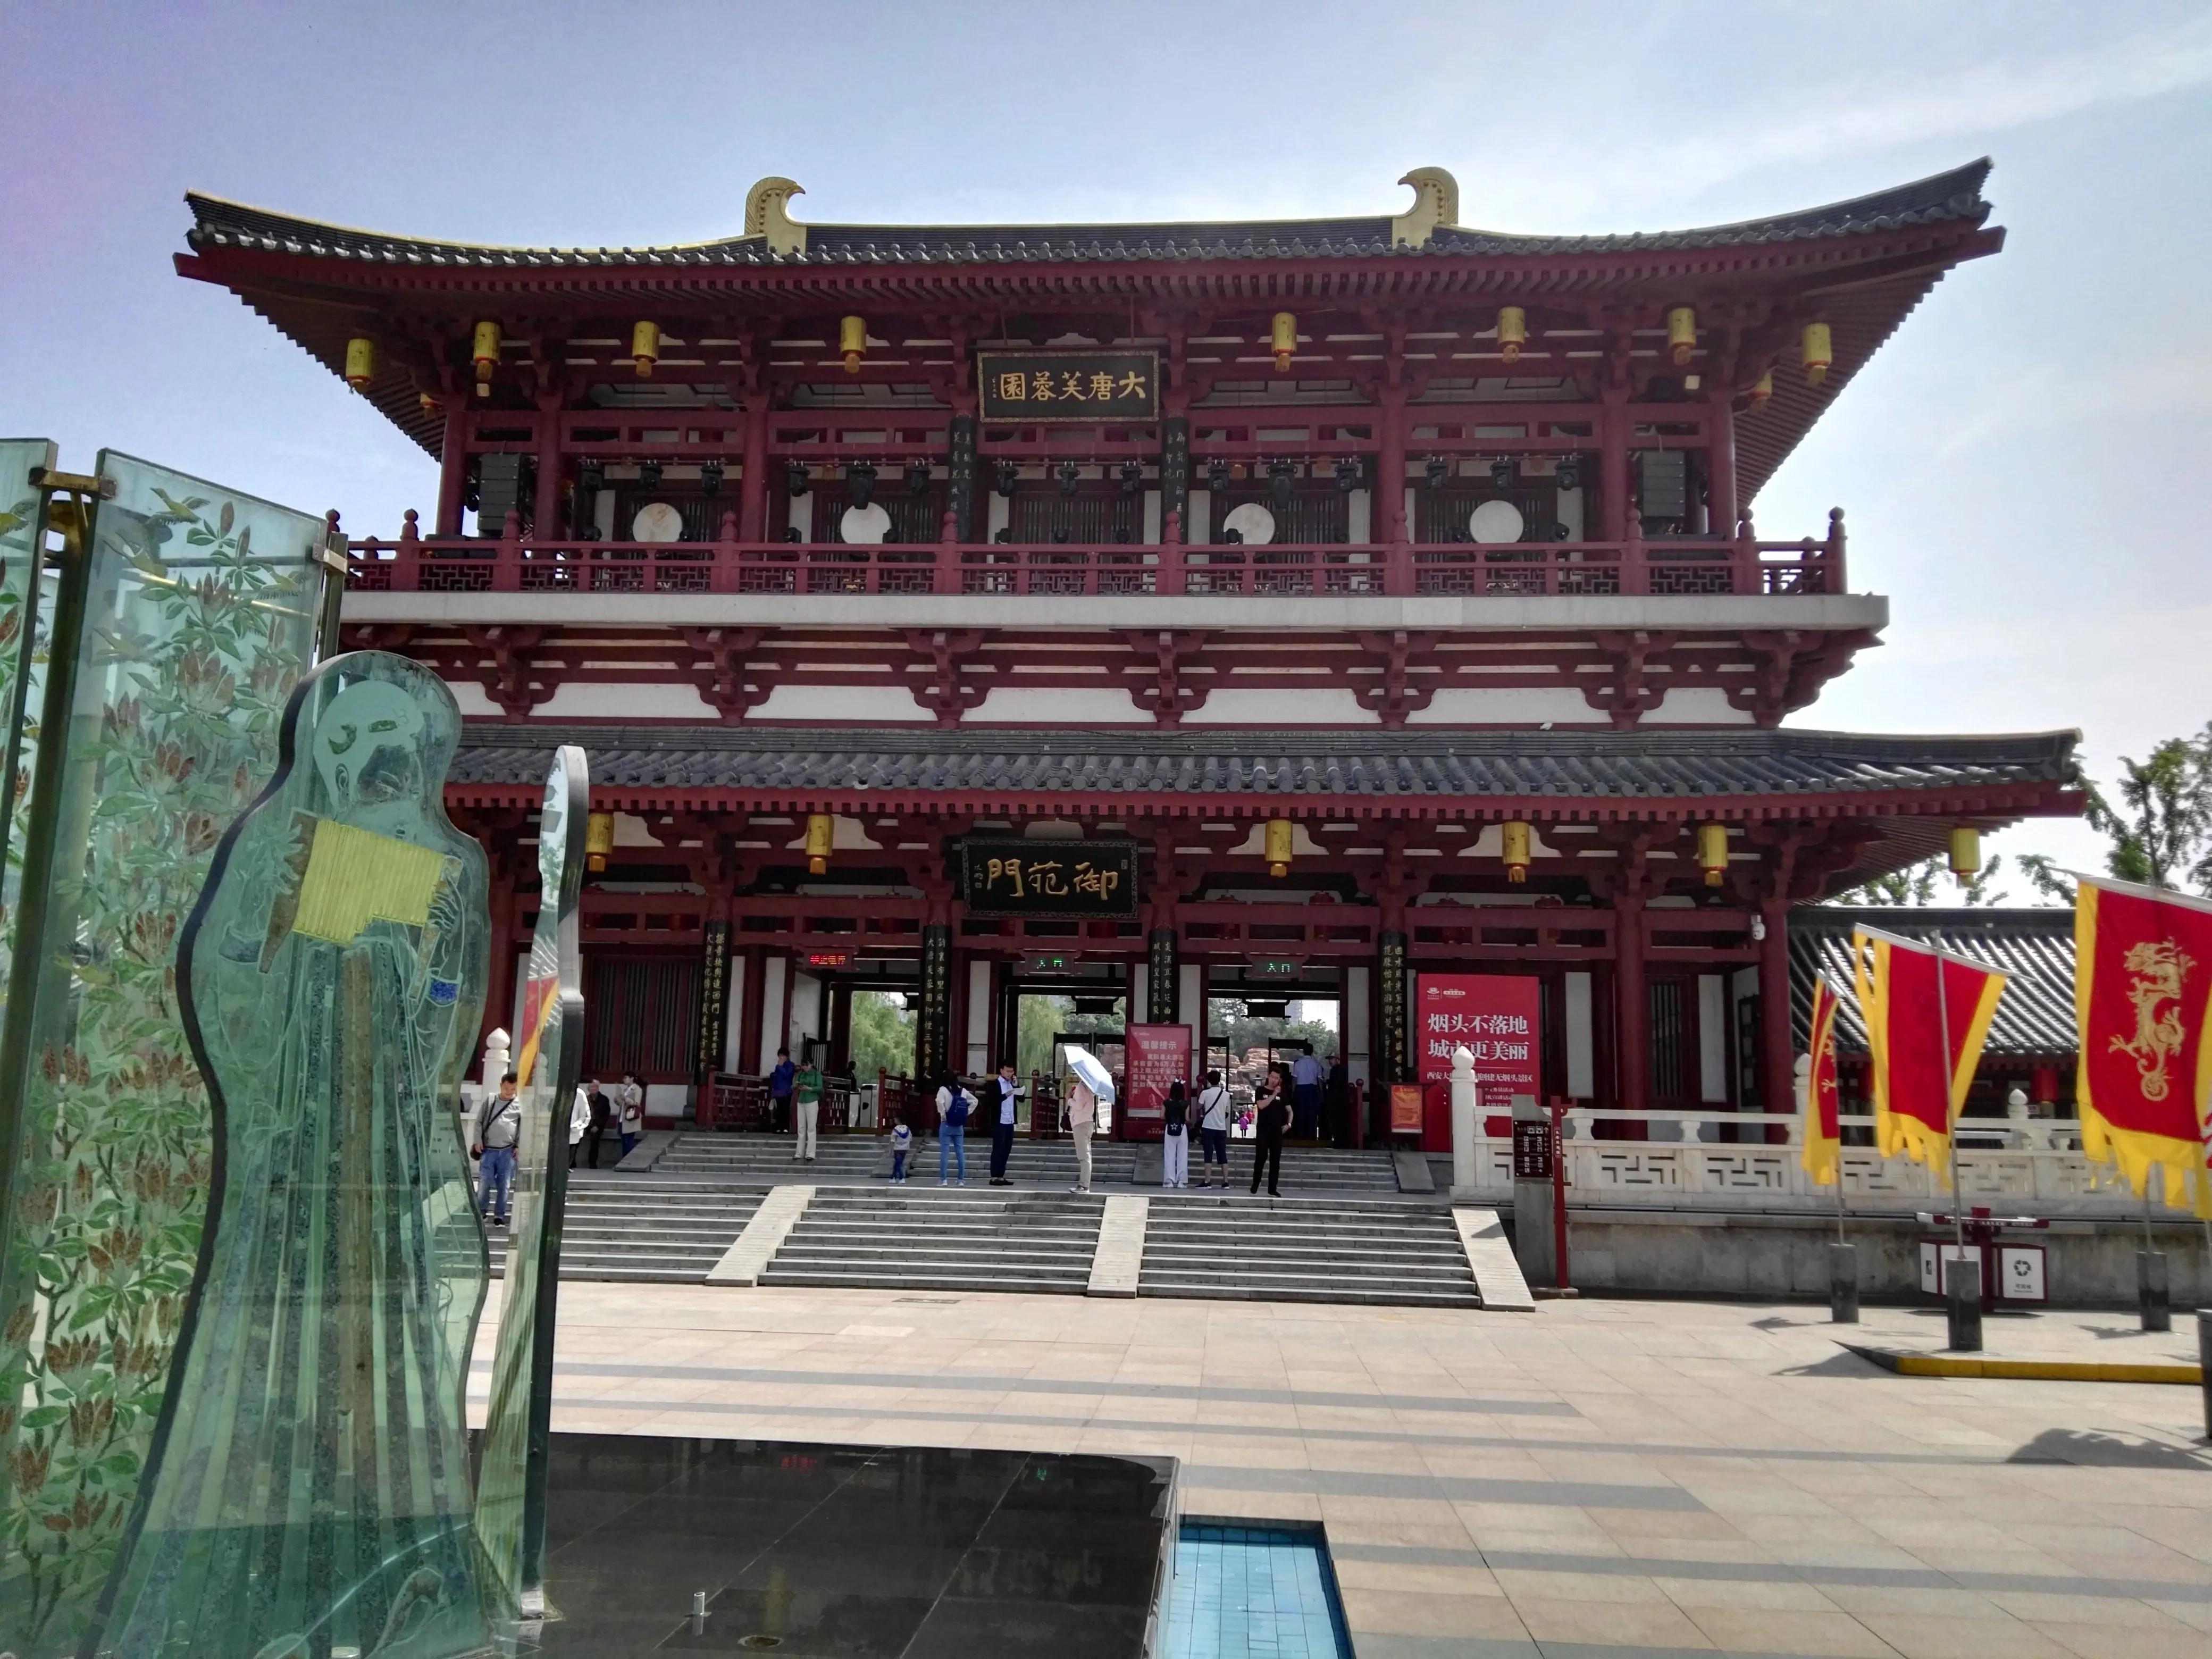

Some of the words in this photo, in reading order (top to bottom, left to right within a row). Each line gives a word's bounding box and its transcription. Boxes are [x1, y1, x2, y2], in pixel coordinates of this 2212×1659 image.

[1000, 371, 1146, 400] 大唐芙蓉園
[986, 858, 1118, 900] 御苑門
[1428, 1013, 1529, 1034] 烟头不落地
[1141, 1040, 1177, 1050] 温馨提示
